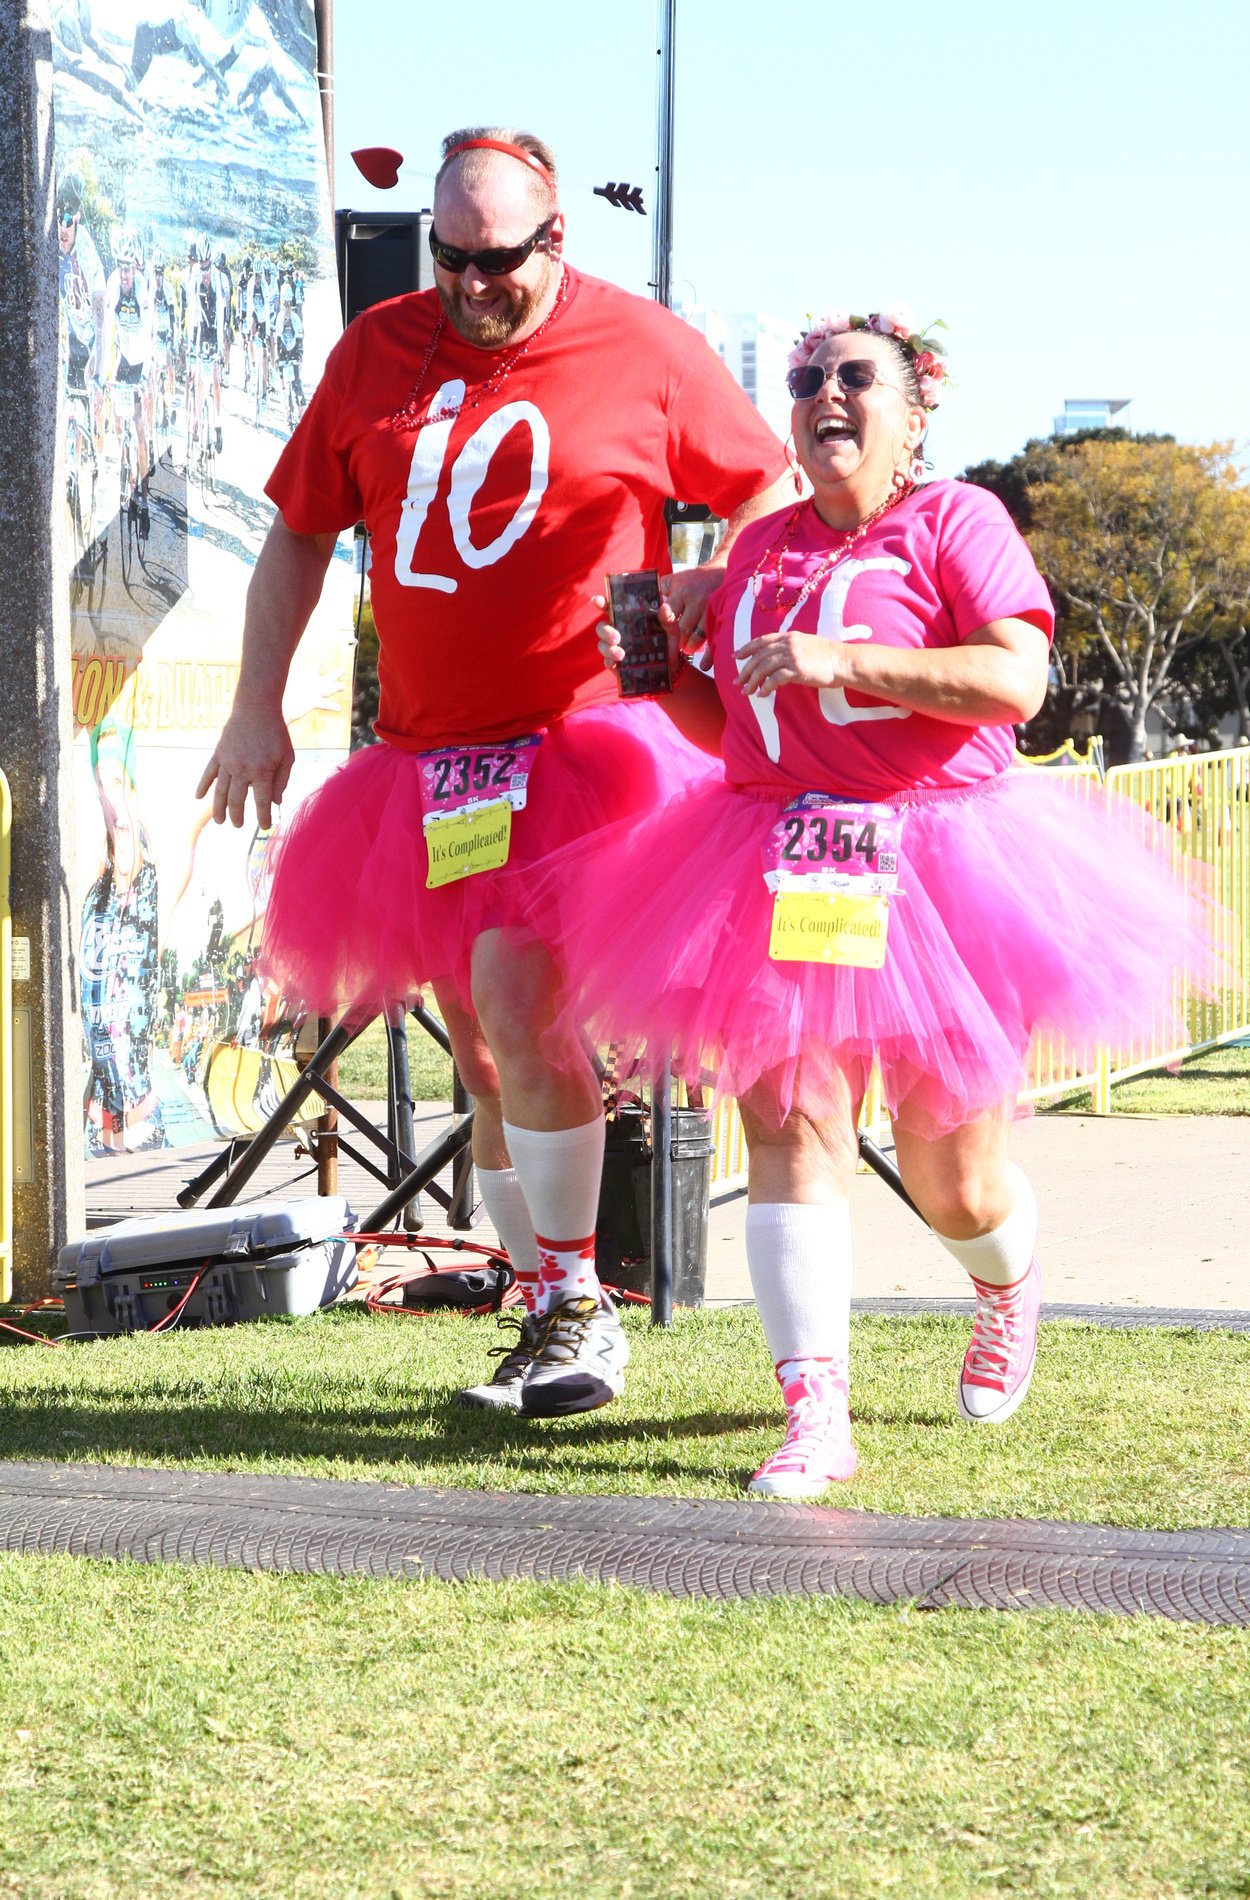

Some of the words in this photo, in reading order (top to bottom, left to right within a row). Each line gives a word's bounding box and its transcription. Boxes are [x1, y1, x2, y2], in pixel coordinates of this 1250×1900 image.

[394, 378, 551, 594] LO
[733, 555, 913, 764] VE
[433, 752, 517, 801] 2352
[432, 844, 446, 863] It's
[448, 825, 508, 858] Complicated!
[781, 817, 877, 863] 2354
[777, 915, 795, 932] It's
[799, 915, 882, 938] Complicated!
